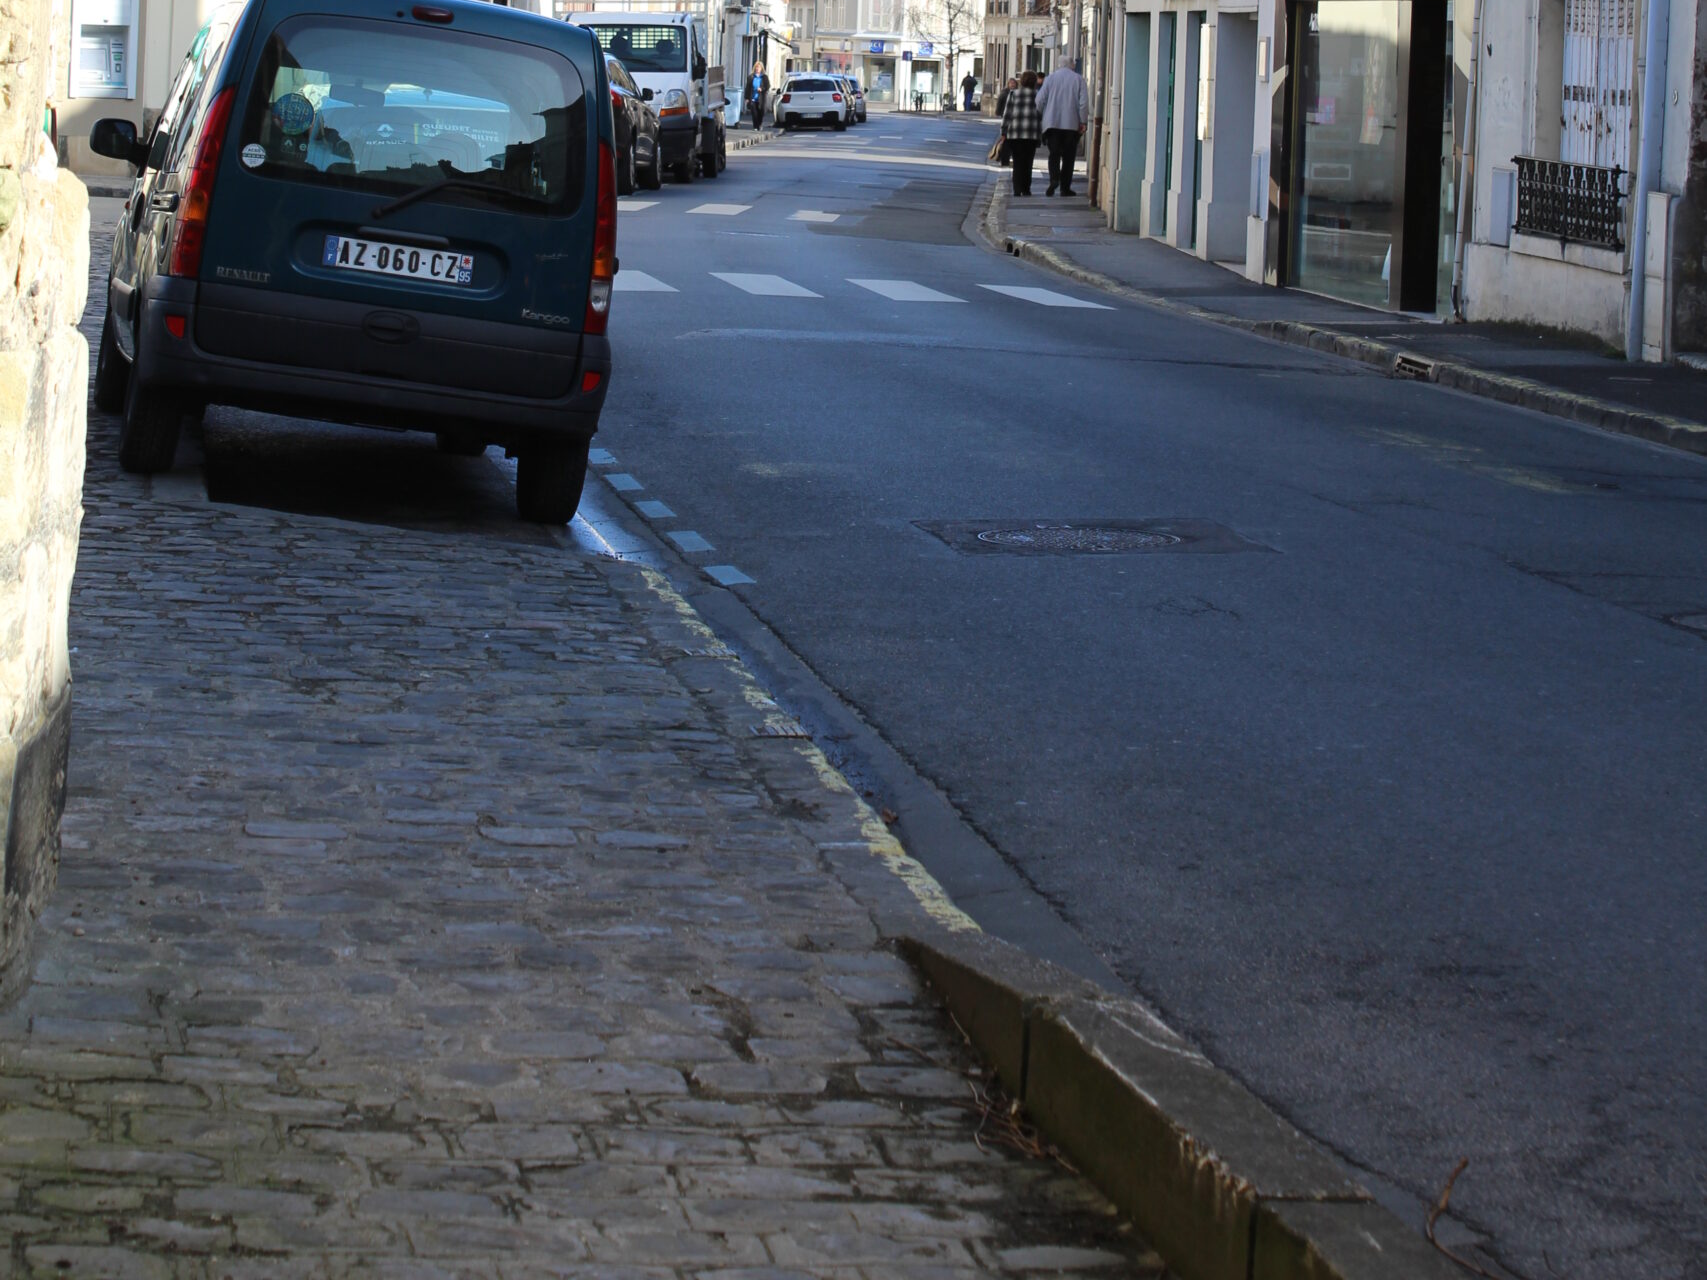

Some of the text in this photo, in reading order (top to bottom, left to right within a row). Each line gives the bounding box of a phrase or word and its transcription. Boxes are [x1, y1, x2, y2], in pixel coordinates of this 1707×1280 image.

[217, 266, 270, 283] RENAULT
[339, 240, 459, 280] AZ-060-CZ
[458, 271, 471, 283] 95
